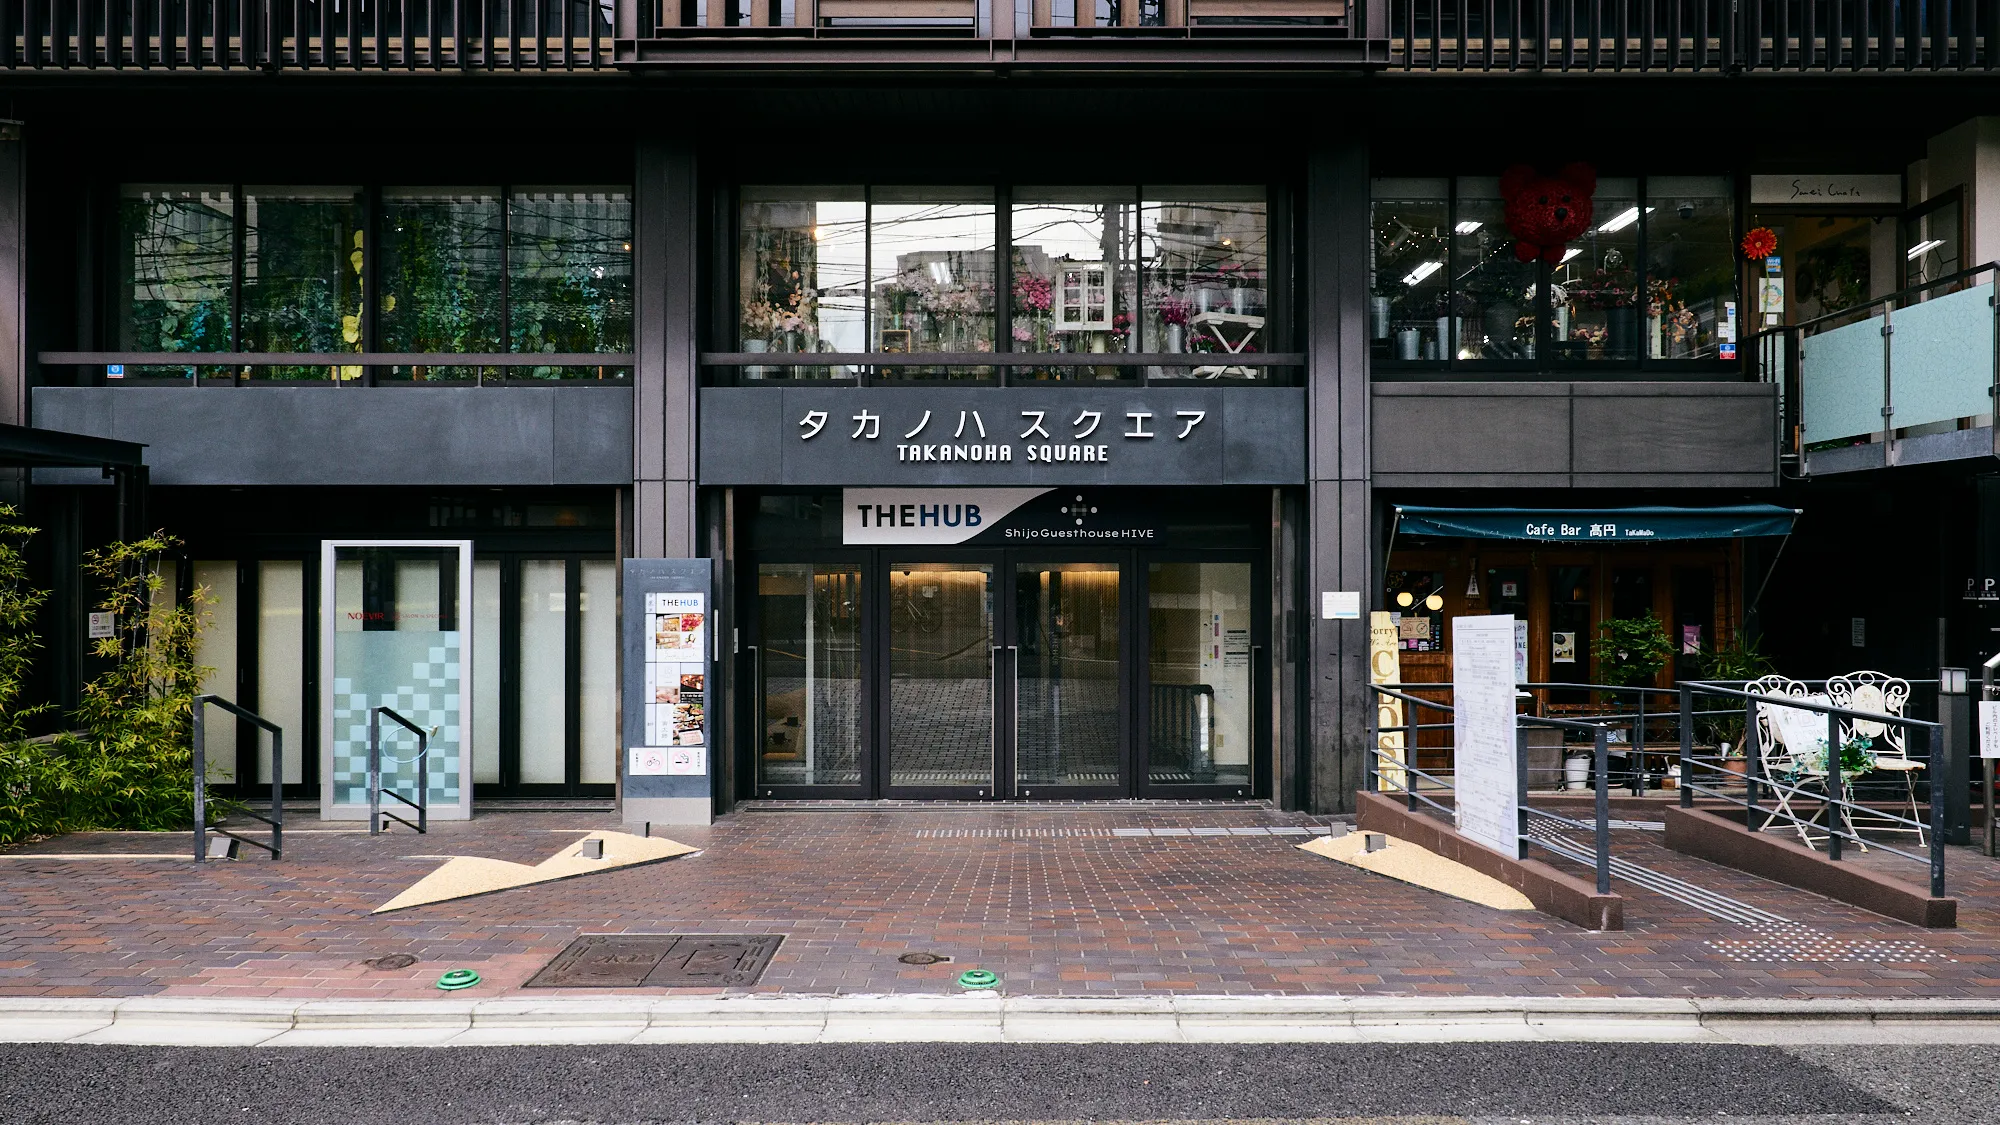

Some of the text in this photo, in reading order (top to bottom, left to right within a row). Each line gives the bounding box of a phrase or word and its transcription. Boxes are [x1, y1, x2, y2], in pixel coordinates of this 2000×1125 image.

[897, 444, 1109, 462] TAKANOHA SQUARE
[1005, 528, 1154, 539] Shijo Guesthouse HIVE
[1526, 523, 1555, 536] Cafe
[1560, 523, 1582, 536] Bar
[1967, 578, 1975, 591] P
[1984, 578, 1996, 591] P
[347, 612, 385, 620] NOEVIR
